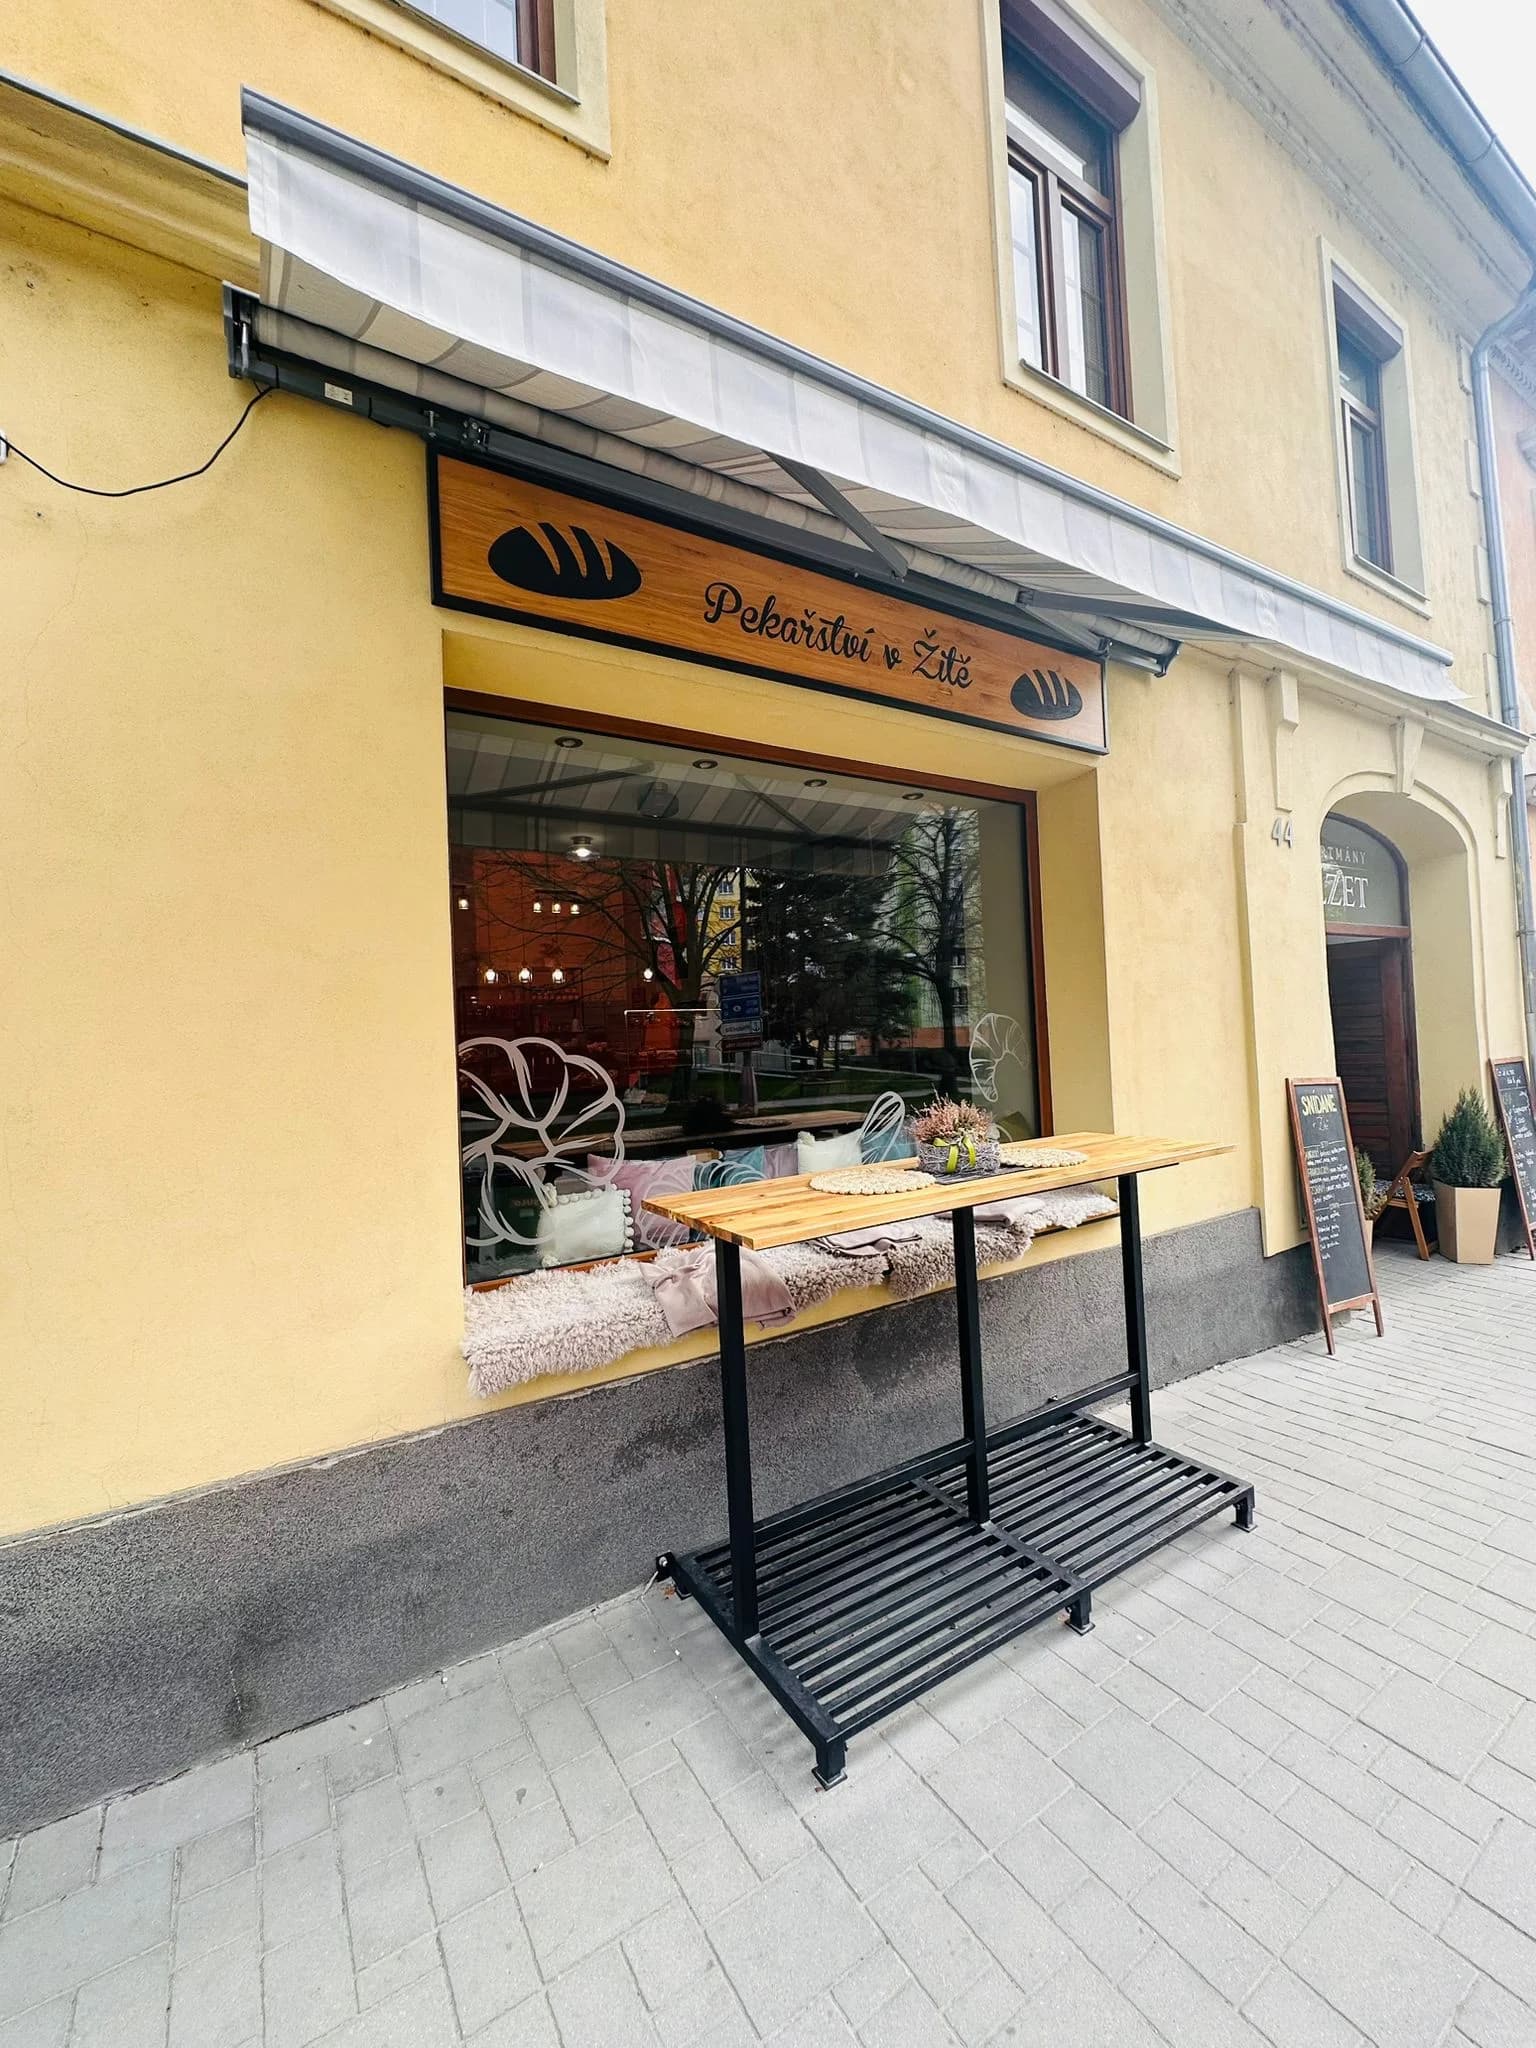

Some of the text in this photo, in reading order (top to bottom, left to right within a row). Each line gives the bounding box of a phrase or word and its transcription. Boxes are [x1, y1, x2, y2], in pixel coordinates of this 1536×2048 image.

[703, 582, 973, 688] Pekařství v Žitě
[1271, 816, 1295, 849] 44
[1320, 845, 1366, 865] RTMÁNY
[1323, 871, 1369, 908] ZET
